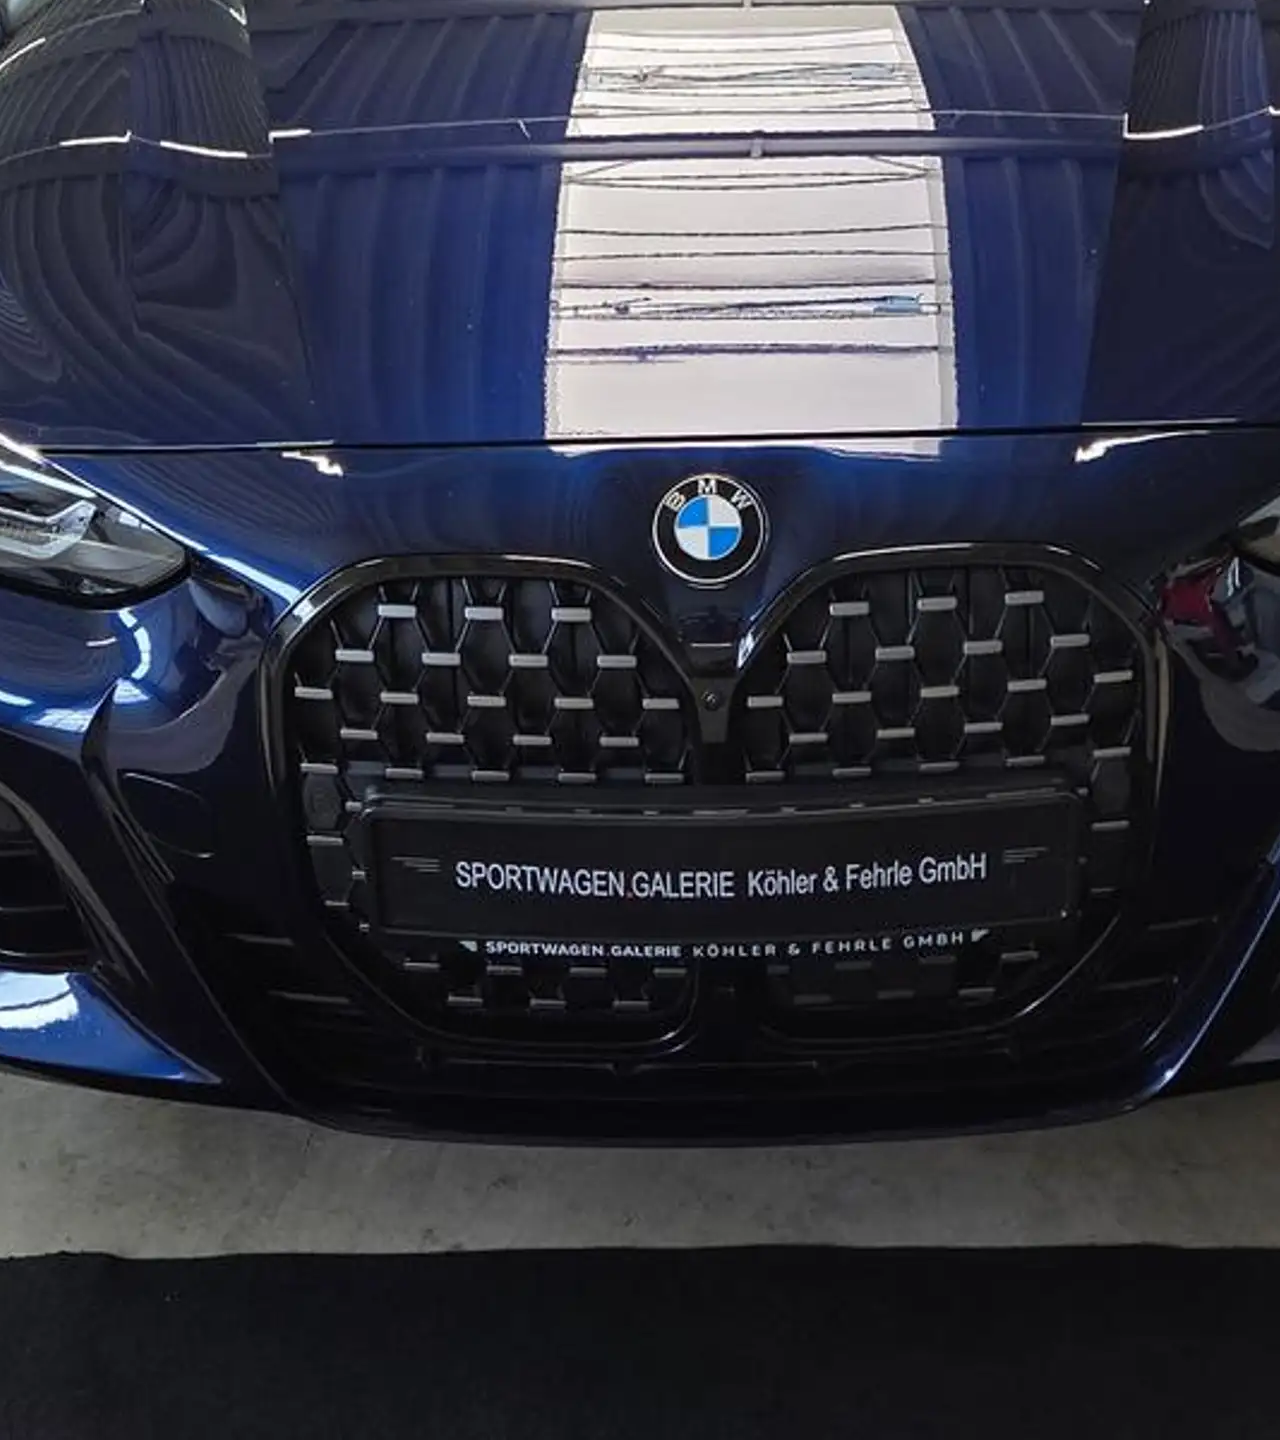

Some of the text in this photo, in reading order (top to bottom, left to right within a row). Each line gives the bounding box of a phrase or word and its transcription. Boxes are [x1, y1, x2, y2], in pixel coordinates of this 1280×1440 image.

[662, 479, 752, 512] BMW
[747, 869, 818, 898] Köhler
[822, 866, 839, 893] &
[845, 861, 913, 891] Fehrle
[918, 852, 987, 884] GmbH
[692, 943, 777, 958] KÖHLER
[787, 942, 801, 956] &
[811, 937, 892, 955] FEHRLE
[903, 929, 964, 950] GMBH
